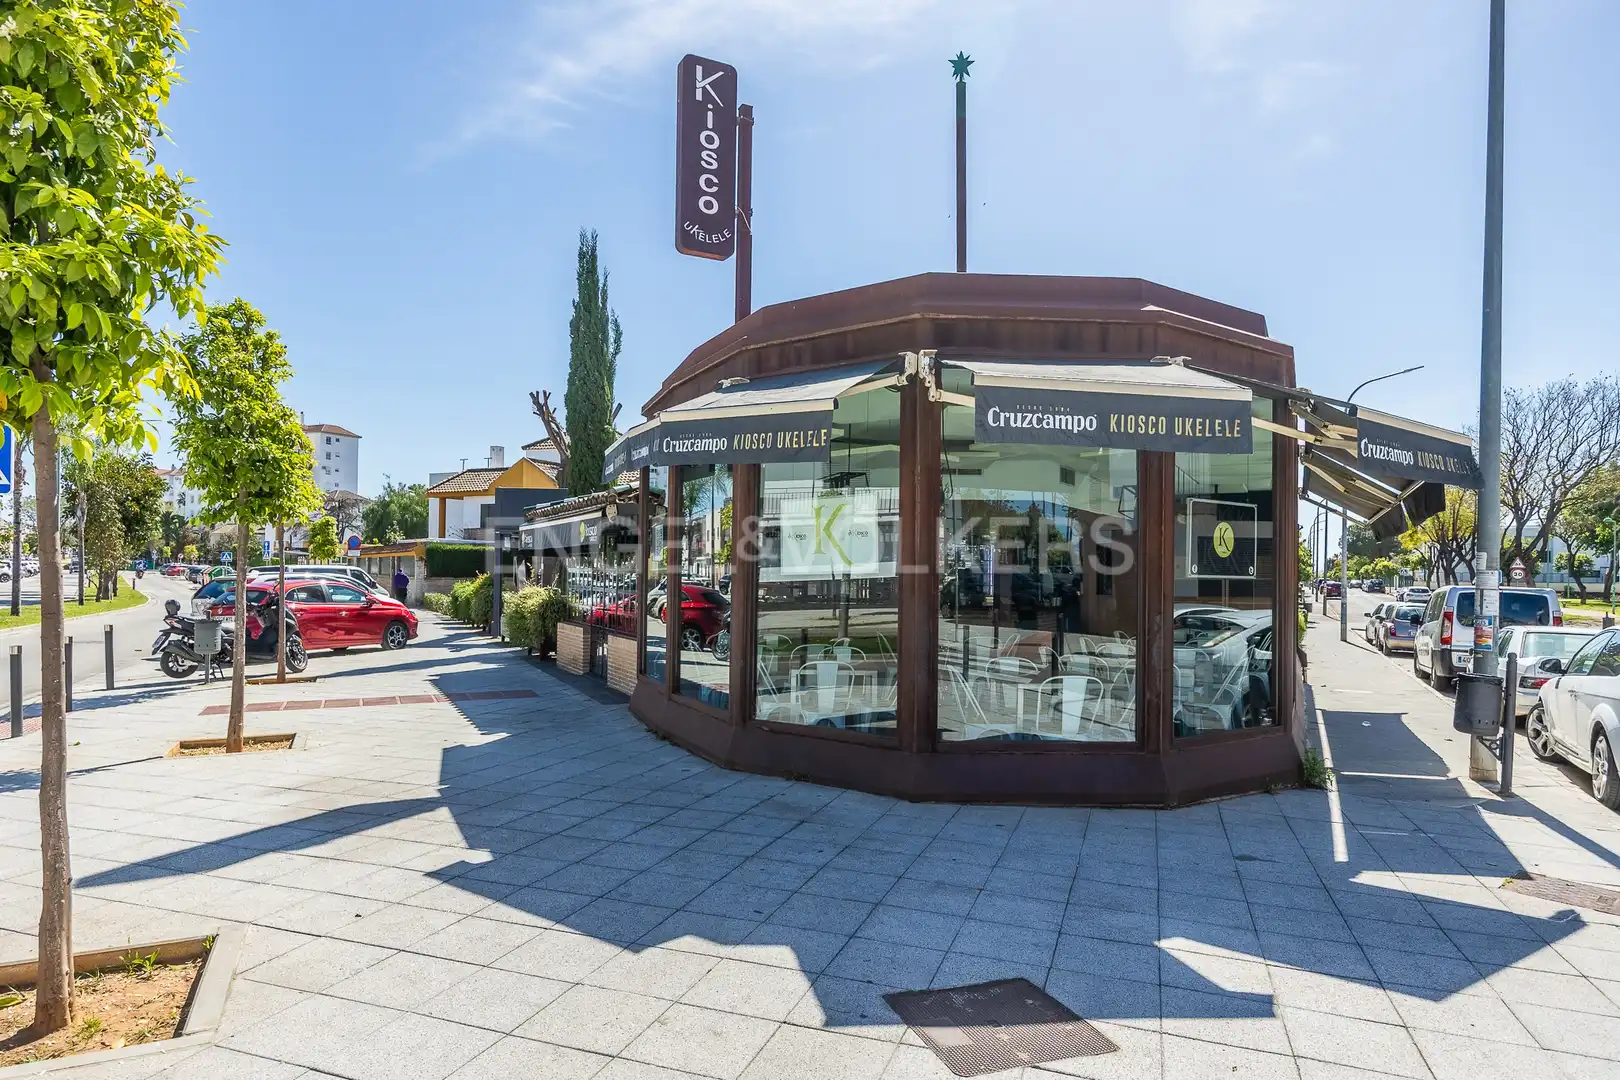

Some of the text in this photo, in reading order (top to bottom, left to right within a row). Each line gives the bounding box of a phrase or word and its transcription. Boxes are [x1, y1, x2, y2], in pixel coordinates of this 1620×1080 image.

[987, 405, 1241, 438] Cruzcampo KIOSCO UKELELE
[663, 435, 728, 454] Cruzcampo
[733, 432, 773, 450] KIOSCO
[777, 428, 828, 449] UKELELE
[1360, 437, 1414, 466] Cruzcampo
[1416, 450, 1445, 471] KIOSCO
[812, 503, 855, 567] K
[1218, 526, 1231, 551] K
